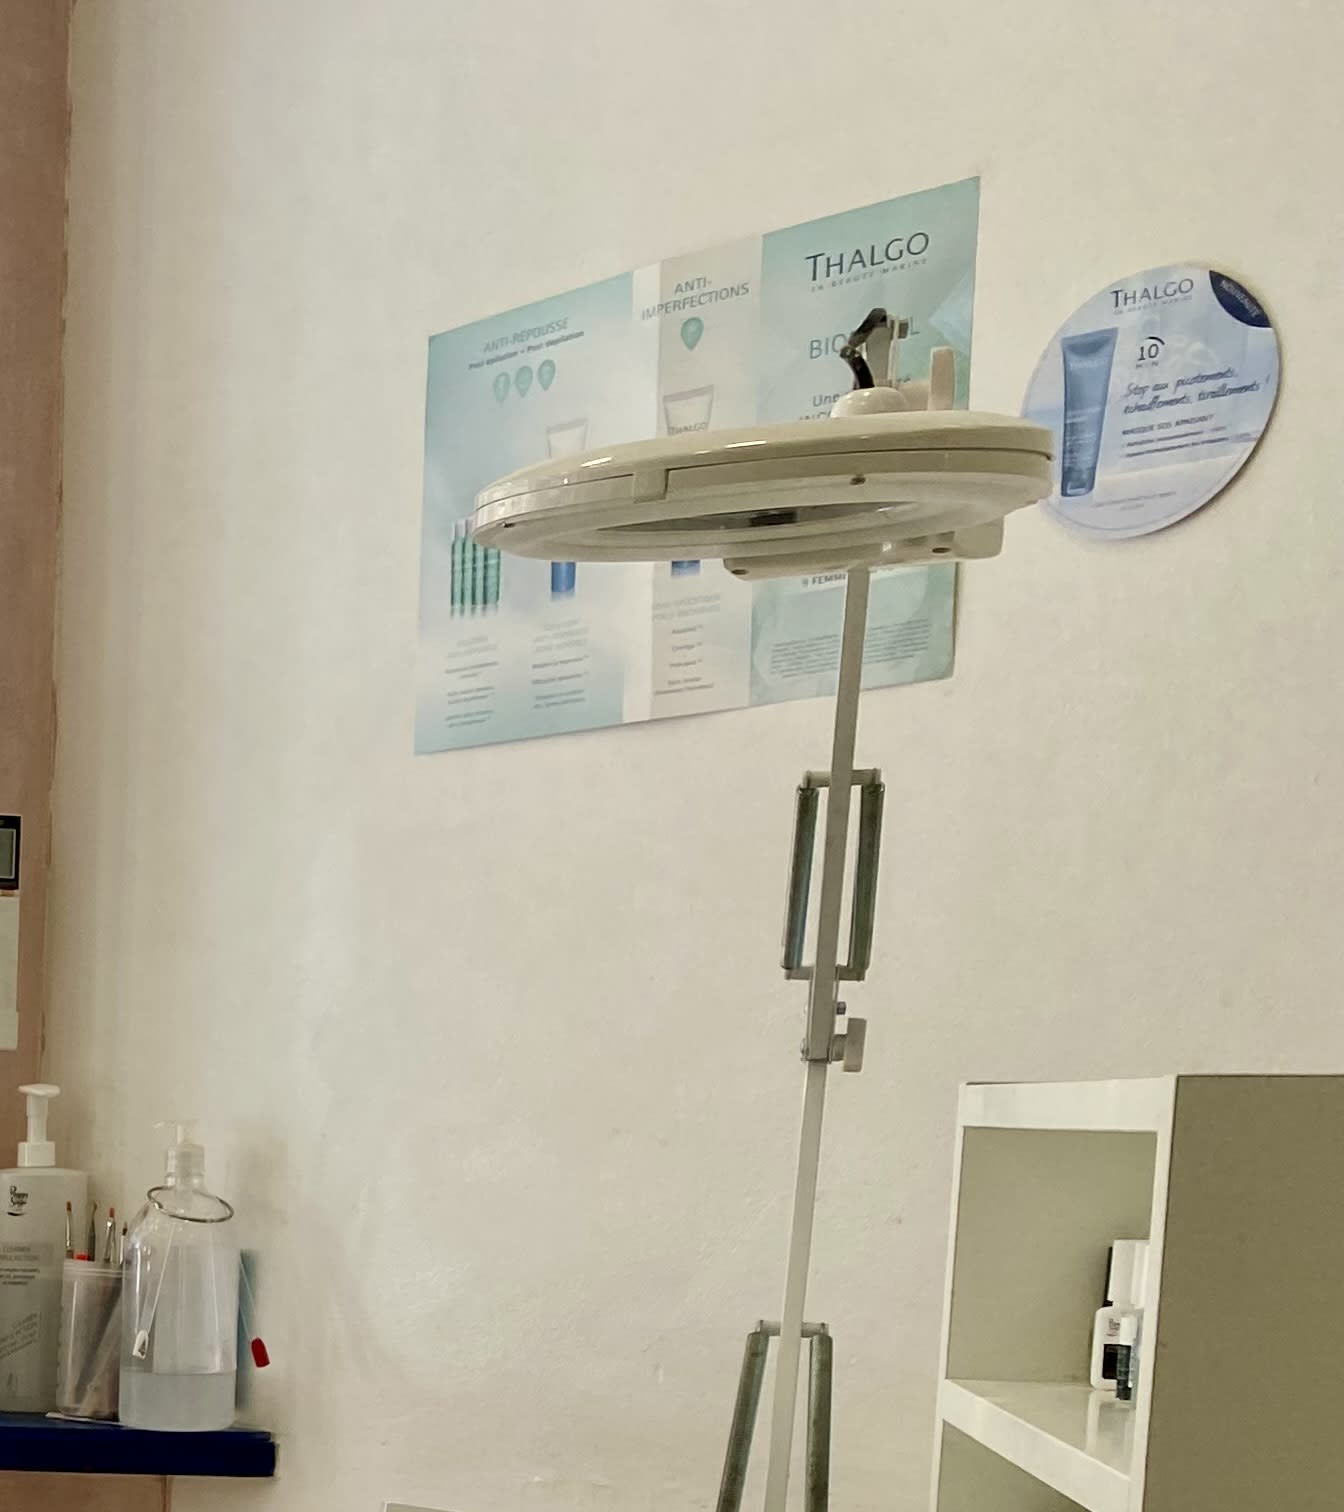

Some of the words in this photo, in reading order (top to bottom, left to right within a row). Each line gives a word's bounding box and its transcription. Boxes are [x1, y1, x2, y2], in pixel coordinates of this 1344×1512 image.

[805, 232, 929, 281] THALGO
[674, 277, 712, 294] ANTI-
[1110, 278, 1194, 308] THALGO
[642, 282, 750, 321] IMPERFECTIONS
[1137, 344, 1160, 361] 10
